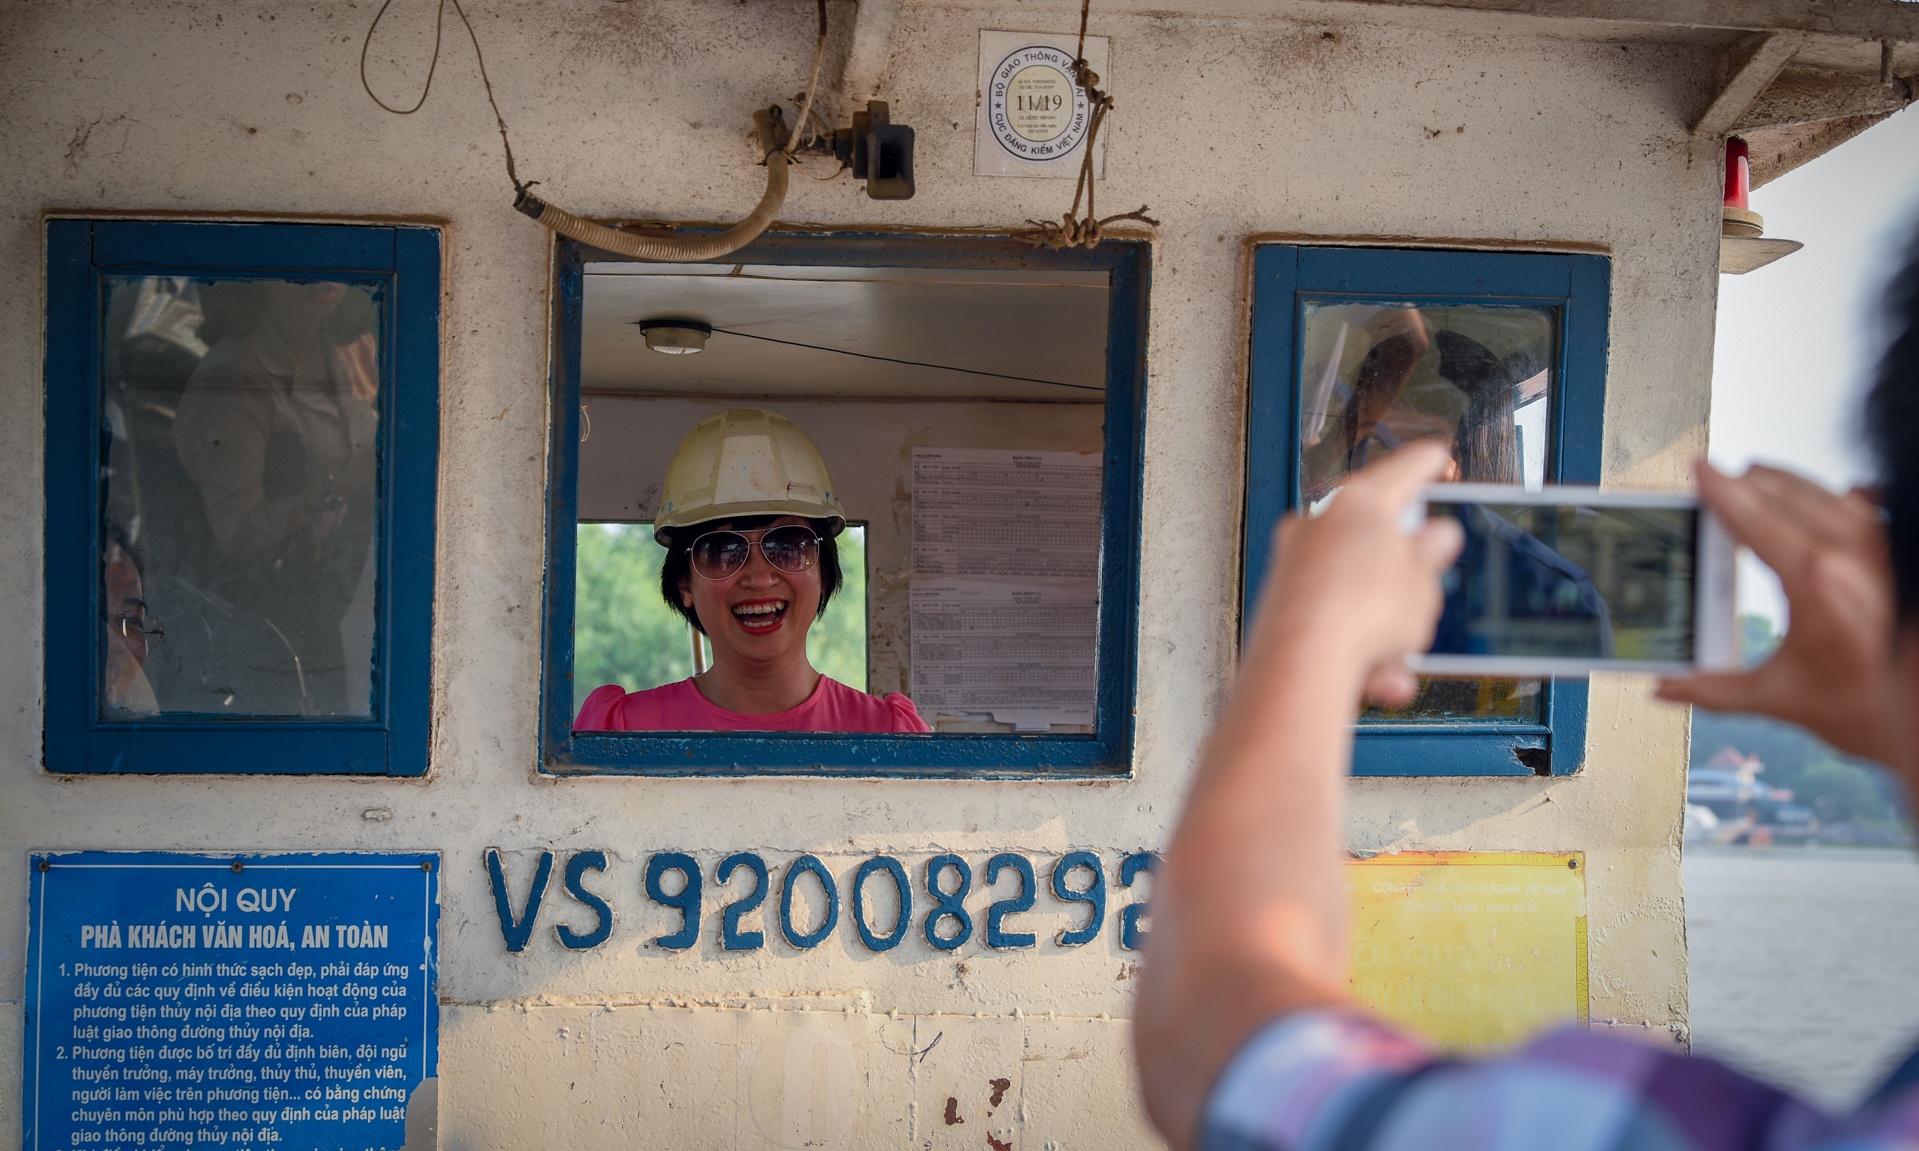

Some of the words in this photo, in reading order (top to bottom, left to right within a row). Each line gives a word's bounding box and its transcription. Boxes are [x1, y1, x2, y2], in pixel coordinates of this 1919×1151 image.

[995, 82, 1004, 97] BỘ
[1001, 58, 1021, 79] GIAO
[1024, 50, 1059, 63] THÔNG
[1017, 94, 1063, 111] 11/19
[994, 113, 1007, 133] CỤC
[1004, 133, 1028, 153] ĐĂNG
[1030, 142, 1054, 155] KIỂM
[1055, 134, 1074, 150] VIỆT
[1072, 113, 1084, 133] NAM
[175, 881, 228, 918] NỘI
[236, 887, 297, 913] QUY
[1491, 881, 1521, 895] NGHĨA
[1523, 881, 1543, 897] VIỆT
[1544, 884, 1567, 895] NAM
[484, 848, 614, 952] VS
[80, 920, 122, 949] PHÀ
[127, 920, 197, 949] KHÁCH
[201, 920, 243, 949] VĂN
[248, 920, 296, 952] HOÁ,
[300, 924, 330, 949] AN
[335, 919, 389, 949] TOÀN
[59, 962, 71, 977] 1.
[74, 962, 128, 981] Phương
[131, 962, 158, 981] tiện
[161, 962, 179, 977] có
[180, 962, 213, 980] hình
[215, 961, 247, 977] thức
[250, 962, 284, 981] sạch
[286, 961, 317, 980] đẹp,
[320, 961, 350, 980] phải
[353, 961, 380, 980] đáp
[382, 962, 409, 980] ứng
[73, 981, 100, 1001] đầy
[103, 981, 122, 998] đủ
[125, 983, 151, 998] các
[153, 986, 181, 1001] quy
[184, 982, 216, 1001] định
[219, 981, 237, 998] về
[239, 981, 270, 998] điều
[274, 982, 304, 1001] kiện
[307, 983, 339, 1001] hoạt
[341, 982, 378, 1001] động
[381, 981, 407, 997] của
[73, 1004, 127, 1022] phương
[130, 1003, 157, 1022] tiện
[159, 1002, 192, 1022] thủy
[195, 1003, 217, 1022] nội
[220, 1003, 242, 1022] địa
[245, 1003, 277, 1018] theo
[279, 1007, 307, 1022] quy
[309, 1002, 340, 1021] định
[343, 1002, 369, 1018] của
[372, 1003, 407, 1021] pháp
[73, 1024, 100, 1043] luật
[102, 1025, 133, 1043] giao
[136, 1024, 177, 1043] thông
[180, 1023, 226, 1043] đường
[228, 1022, 260, 1042] thủy
[263, 1023, 286, 1042] nội
[288, 1023, 314, 1042] địa.
[56, 1045, 68, 1060] 2.
[72, 1045, 126, 1063] Phương
[128, 1045, 155, 1063] tiện
[158, 1044, 193, 1063] được
[196, 1043, 216, 1060] bố
[217, 1045, 233, 1060] trí
[235, 1043, 261, 1063] đầy
[263, 1043, 282, 1060] đủ
[285, 1043, 316, 1063] định
[319, 1044, 352, 1061] biên,
[355, 1043, 378, 1062] đội
[381, 1043, 407, 1062] ngũ
[71, 1063, 119, 1084] thuyền
[122, 1063, 172, 1084] trưởng,
[175, 1065, 205, 1084] máy
[207, 1063, 257, 1084] trưởng,
[260, 1063, 292, 1083] thủy
[294, 1063, 321, 1082] thủ,
[324, 1063, 371, 1083] thuyền
[374, 1064, 407, 1081] viên,
[72, 1086, 111, 1105] người
[115, 1086, 140, 1101] làm
[143, 1086, 172, 1105] việc
[175, 1086, 203, 1101] trên
[207, 1086, 260, 1104] phương
[263, 1086, 301, 1104] tiện...
[304, 1085, 322, 1101] có
[325, 1084, 360, 1104] bằng
[363, 1085, 407, 1103] chứng
[71, 1107, 121, 1125] chuyên
[125, 1107, 155, 1122] môn
[158, 1107, 185, 1125] phù
[188, 1107, 215, 1125] hợp
[217, 1107, 249, 1122] theo
[251, 1110, 278, 1125] quy
[280, 1106, 311, 1125] định
[313, 1104, 339, 1121] của
[342, 1106, 377, 1124] pháp
[379, 1105, 406, 1124] luật
[70, 1128, 102, 1146] giao
[104, 1127, 146, 1146] thông
[149, 1127, 194, 1146] đường
[197, 1125, 229, 1146] thủy
[231, 1127, 254, 1146] nội
[257, 1126, 283, 1146] địa.
